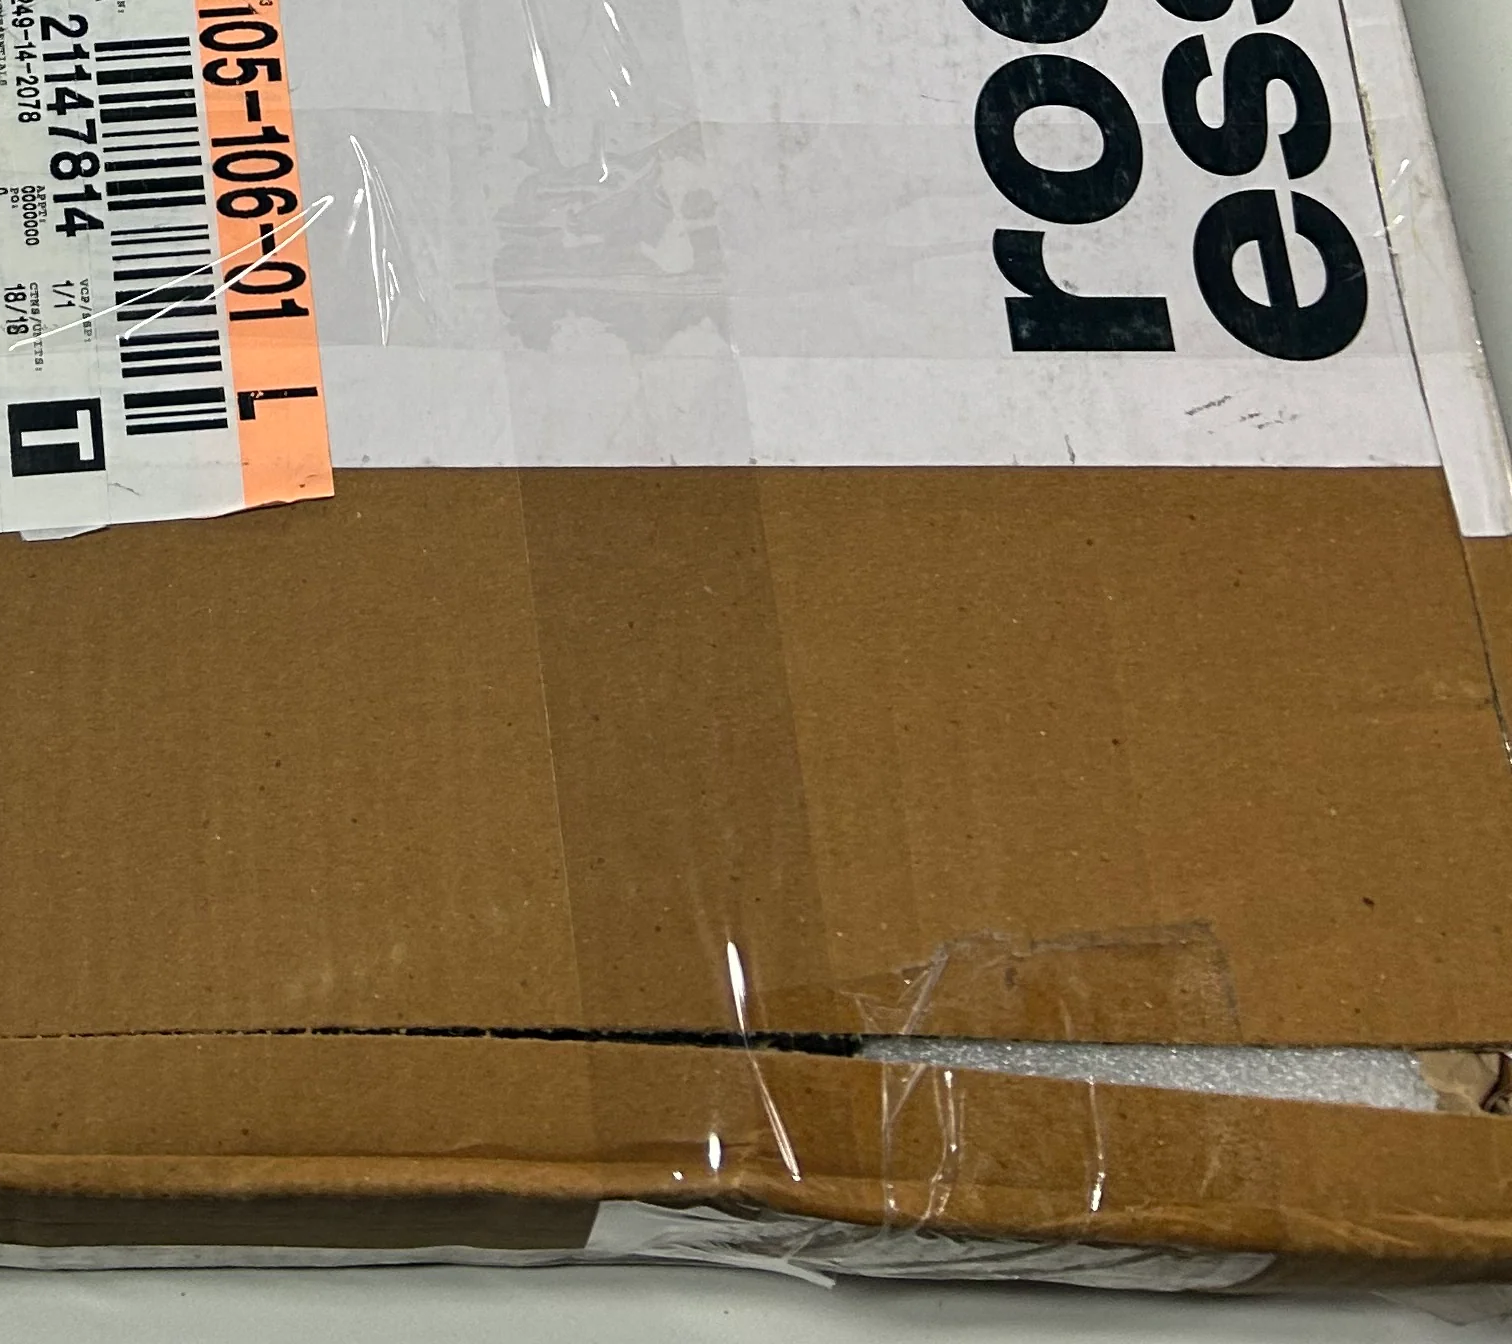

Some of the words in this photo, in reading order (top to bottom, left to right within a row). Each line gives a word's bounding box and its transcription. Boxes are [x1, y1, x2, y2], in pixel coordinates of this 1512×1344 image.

[40, 14, 105, 237] 21147814
[197, 5, 310, 322] 105-106-01
[10, 187, 20, 209] PO:
[21, 185, 40, 246] 0000000
[36, 185, 48, 223] APPT:
[3, 283, 30, 335] 18/18
[52, 279, 76, 309] 1/1
[236, 385, 319, 421] L
